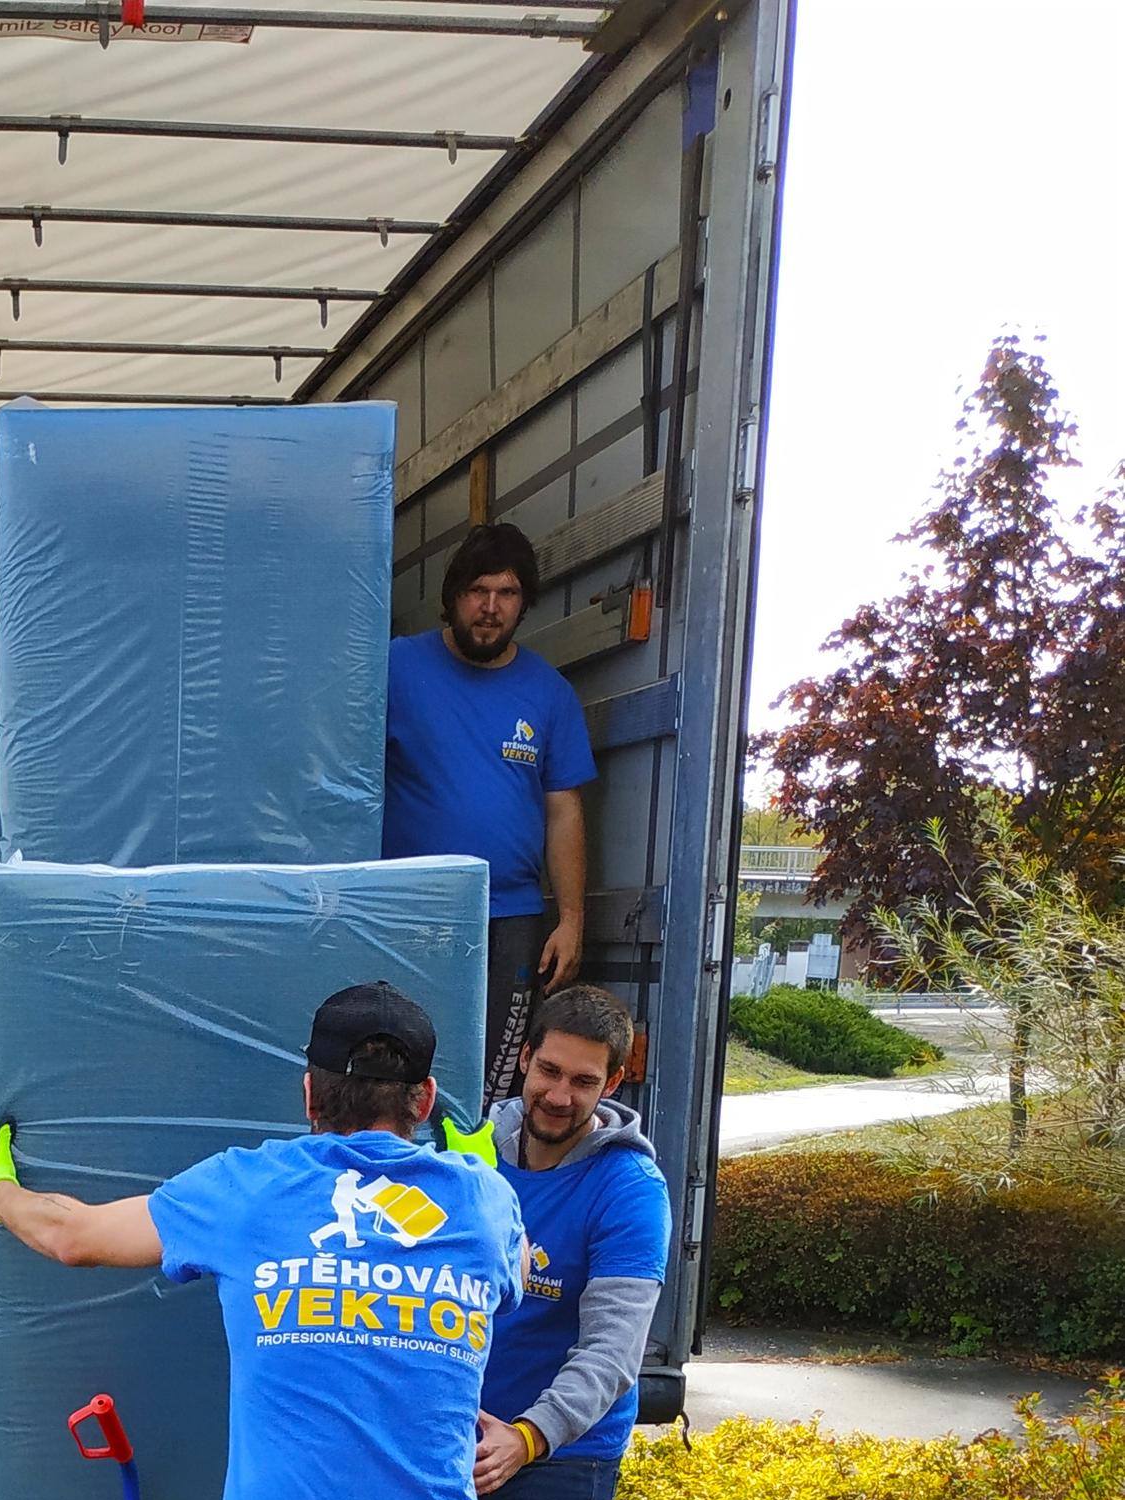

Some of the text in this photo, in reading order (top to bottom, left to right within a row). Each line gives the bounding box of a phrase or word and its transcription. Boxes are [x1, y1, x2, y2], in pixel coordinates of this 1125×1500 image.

[52, 18, 124, 37] Safey
[502, 748, 536, 762] VEKTO
[253, 1252, 491, 1311] STĚHOVÁNÍ
[524, 1282, 562, 1298] KTOS
[253, 1288, 489, 1351] VEKTOS
[256, 1331, 369, 1347] PROFESIONÁLNÍ
[372, 1334, 447, 1355] STĚHOVACÍ
